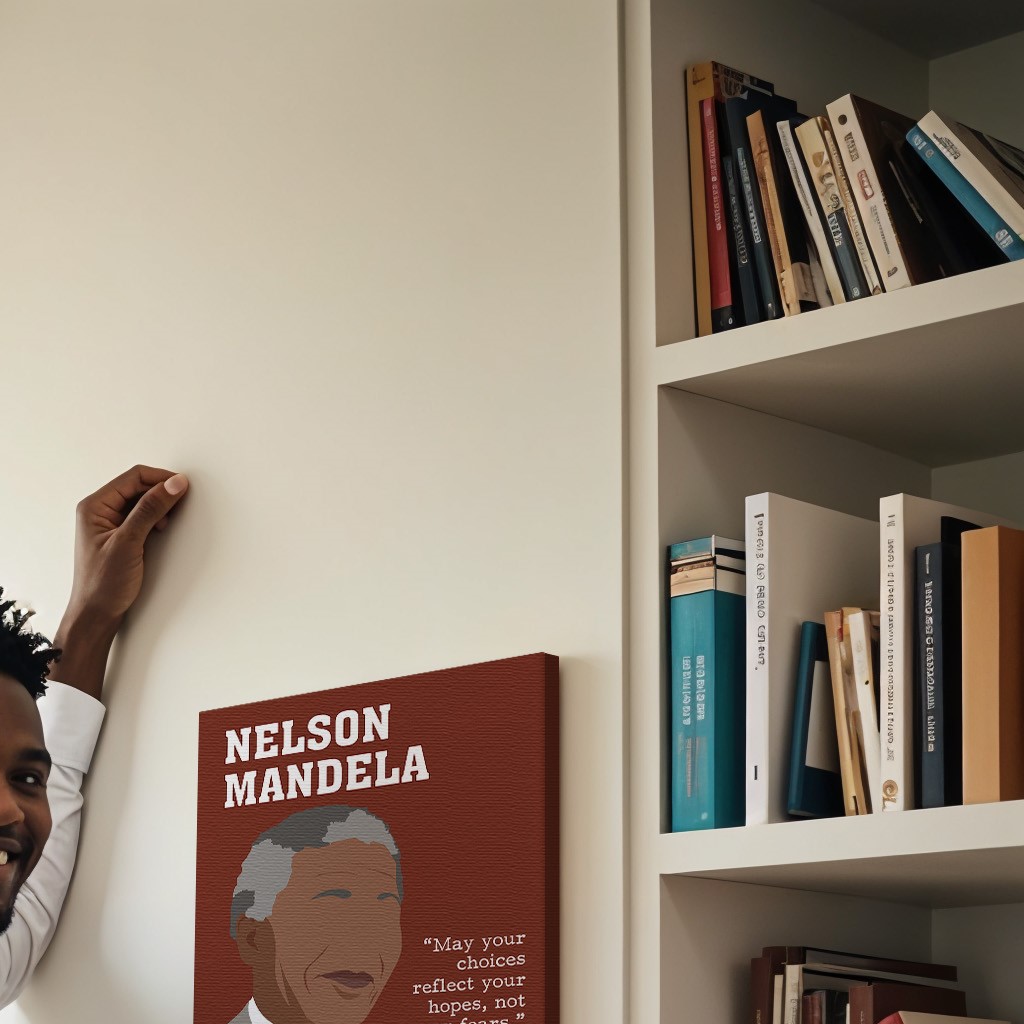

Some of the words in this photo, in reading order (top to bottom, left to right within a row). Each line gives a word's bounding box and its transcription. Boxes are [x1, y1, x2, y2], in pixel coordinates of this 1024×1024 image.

[224, 703, 391, 765] NELSON
[224, 744, 430, 809] MANDELA
[423, 937, 474, 953] “May
[481, 933, 526, 952] your
[456, 953, 526, 971] choices
[412, 977, 475, 995] reflect
[481, 975, 526, 993] your
[427, 999, 487, 1017] hopes,
[494, 994, 526, 1009] not
